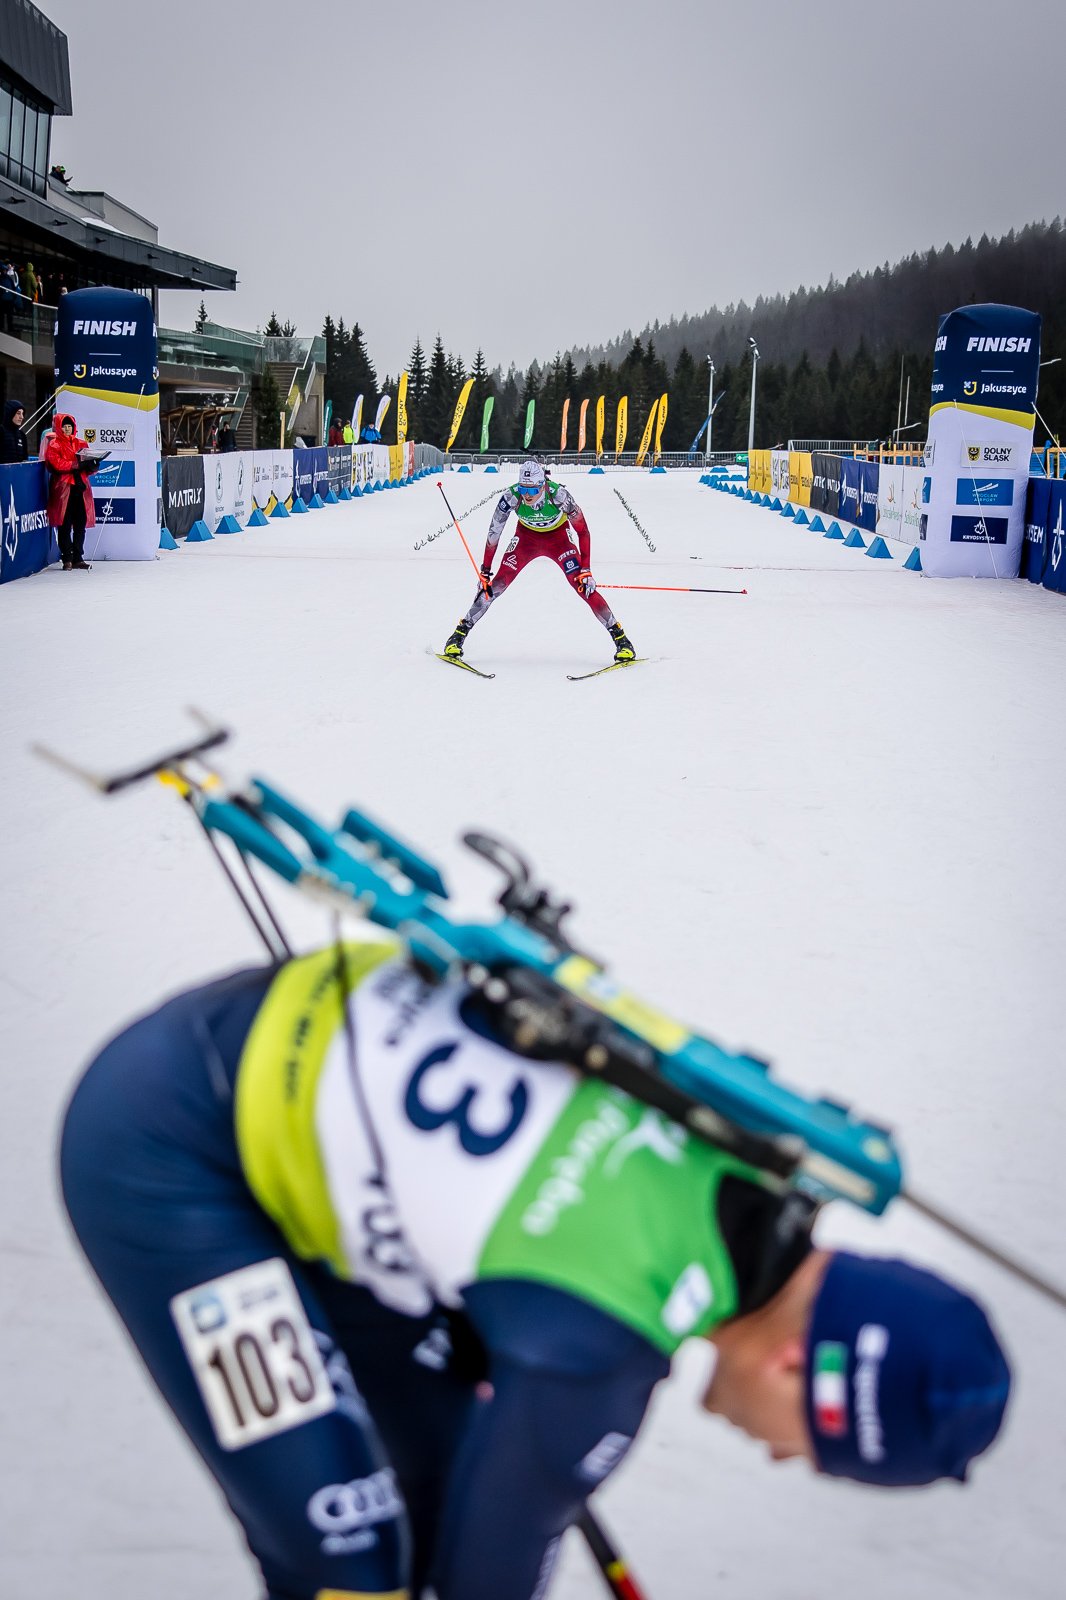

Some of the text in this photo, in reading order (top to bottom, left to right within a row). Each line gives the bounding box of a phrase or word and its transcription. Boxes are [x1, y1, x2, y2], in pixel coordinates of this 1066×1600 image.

[73, 320, 137, 336] FINISH
[966, 337, 1031, 353] FINISH
[90, 365, 137, 378] Jakuszyce
[980, 383, 1027, 395] Jakuszyce
[983, 447, 1012, 455] DOLNY
[168, 487, 203, 508] MATRIX
[20, 510, 50, 533] KRYOSYSTE
[208, 1318, 316, 1427] 103
